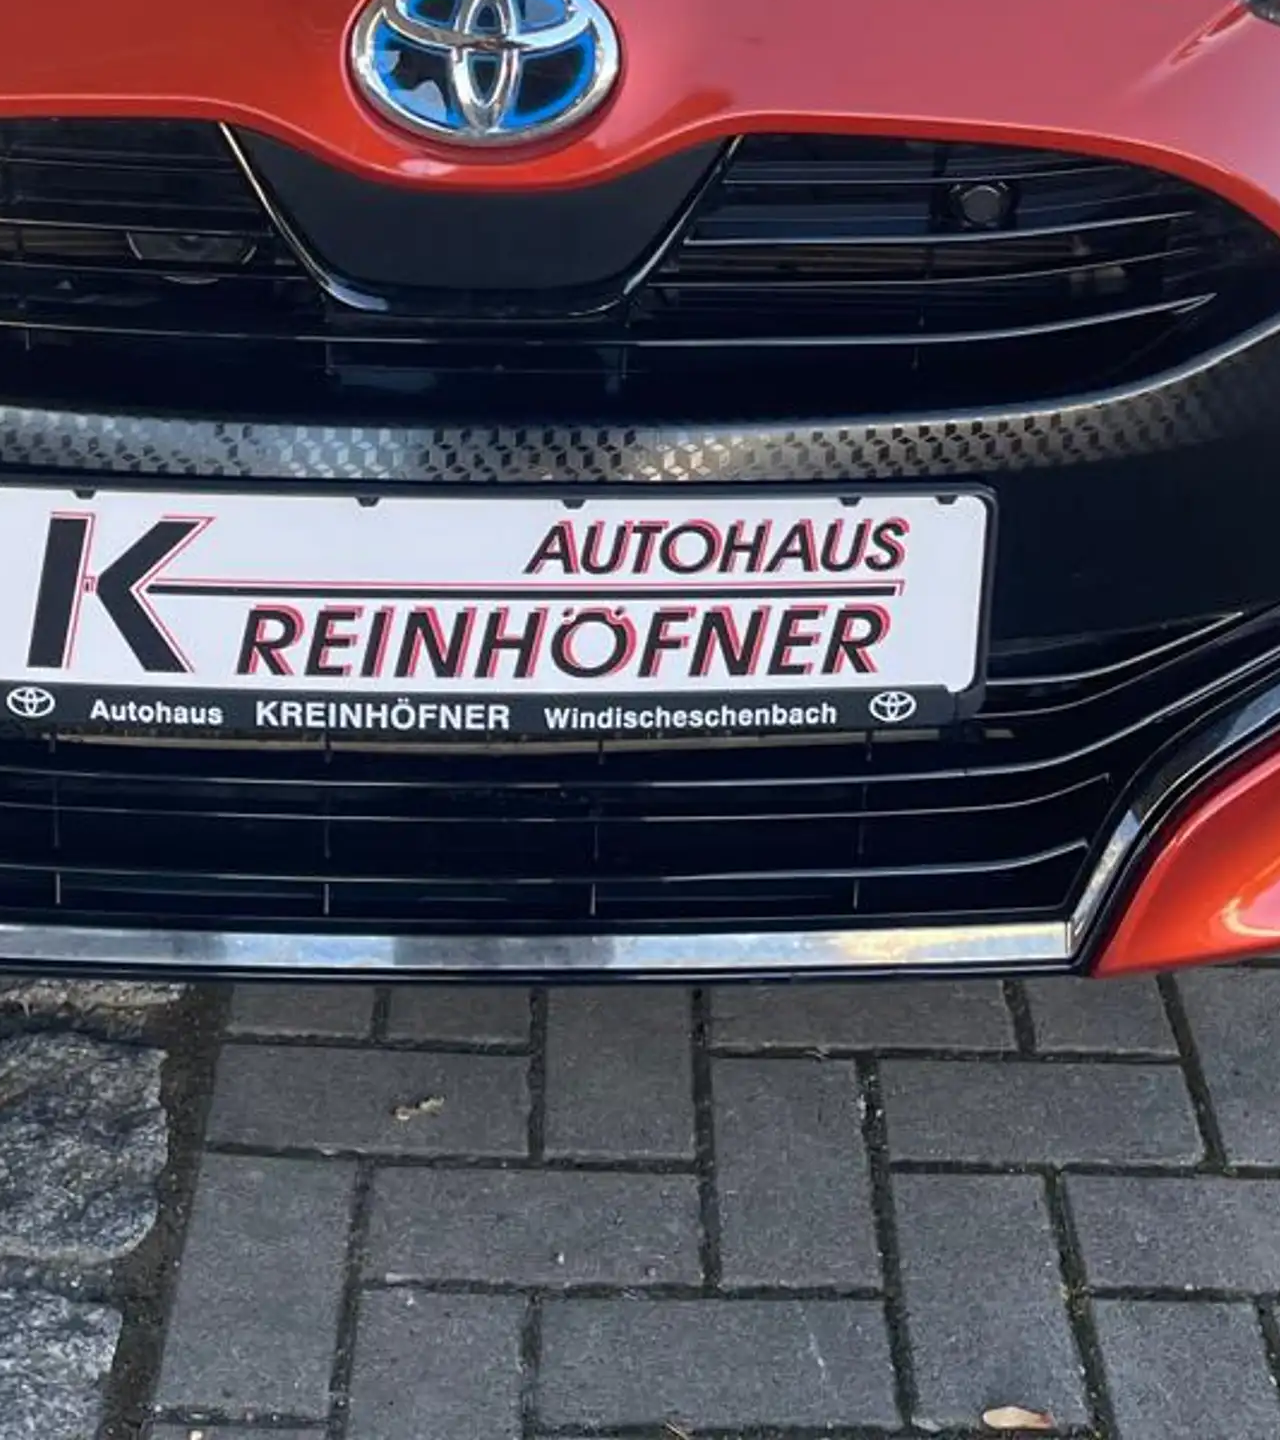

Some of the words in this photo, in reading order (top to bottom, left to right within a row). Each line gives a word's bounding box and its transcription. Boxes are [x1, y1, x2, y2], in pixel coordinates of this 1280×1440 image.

[522, 515, 910, 574] AUTOHAUS
[89, 698, 224, 725] Autohaus
[255, 697, 510, 730] KREINHÖFNER
[543, 703, 837, 730] Windischeschenbach
